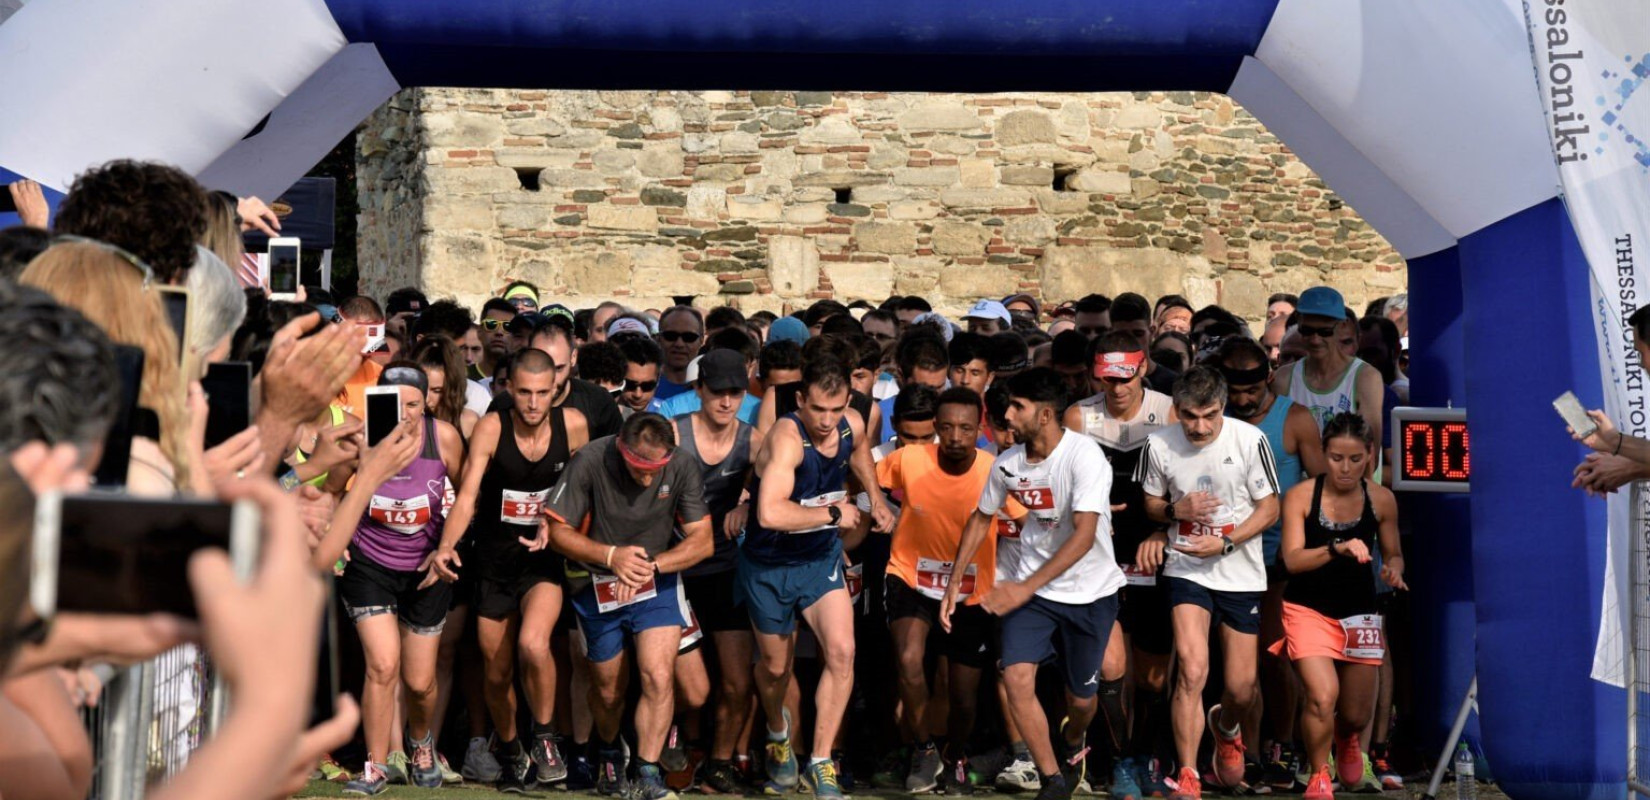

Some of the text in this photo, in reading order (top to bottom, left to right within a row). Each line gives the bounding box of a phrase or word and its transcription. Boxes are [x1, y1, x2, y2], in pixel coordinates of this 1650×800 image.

[1405, 424, 1470, 478] 00
[384, 511, 418, 523] 149
[1191, 522, 1223, 539] 205
[1356, 629, 1381, 645] 232
